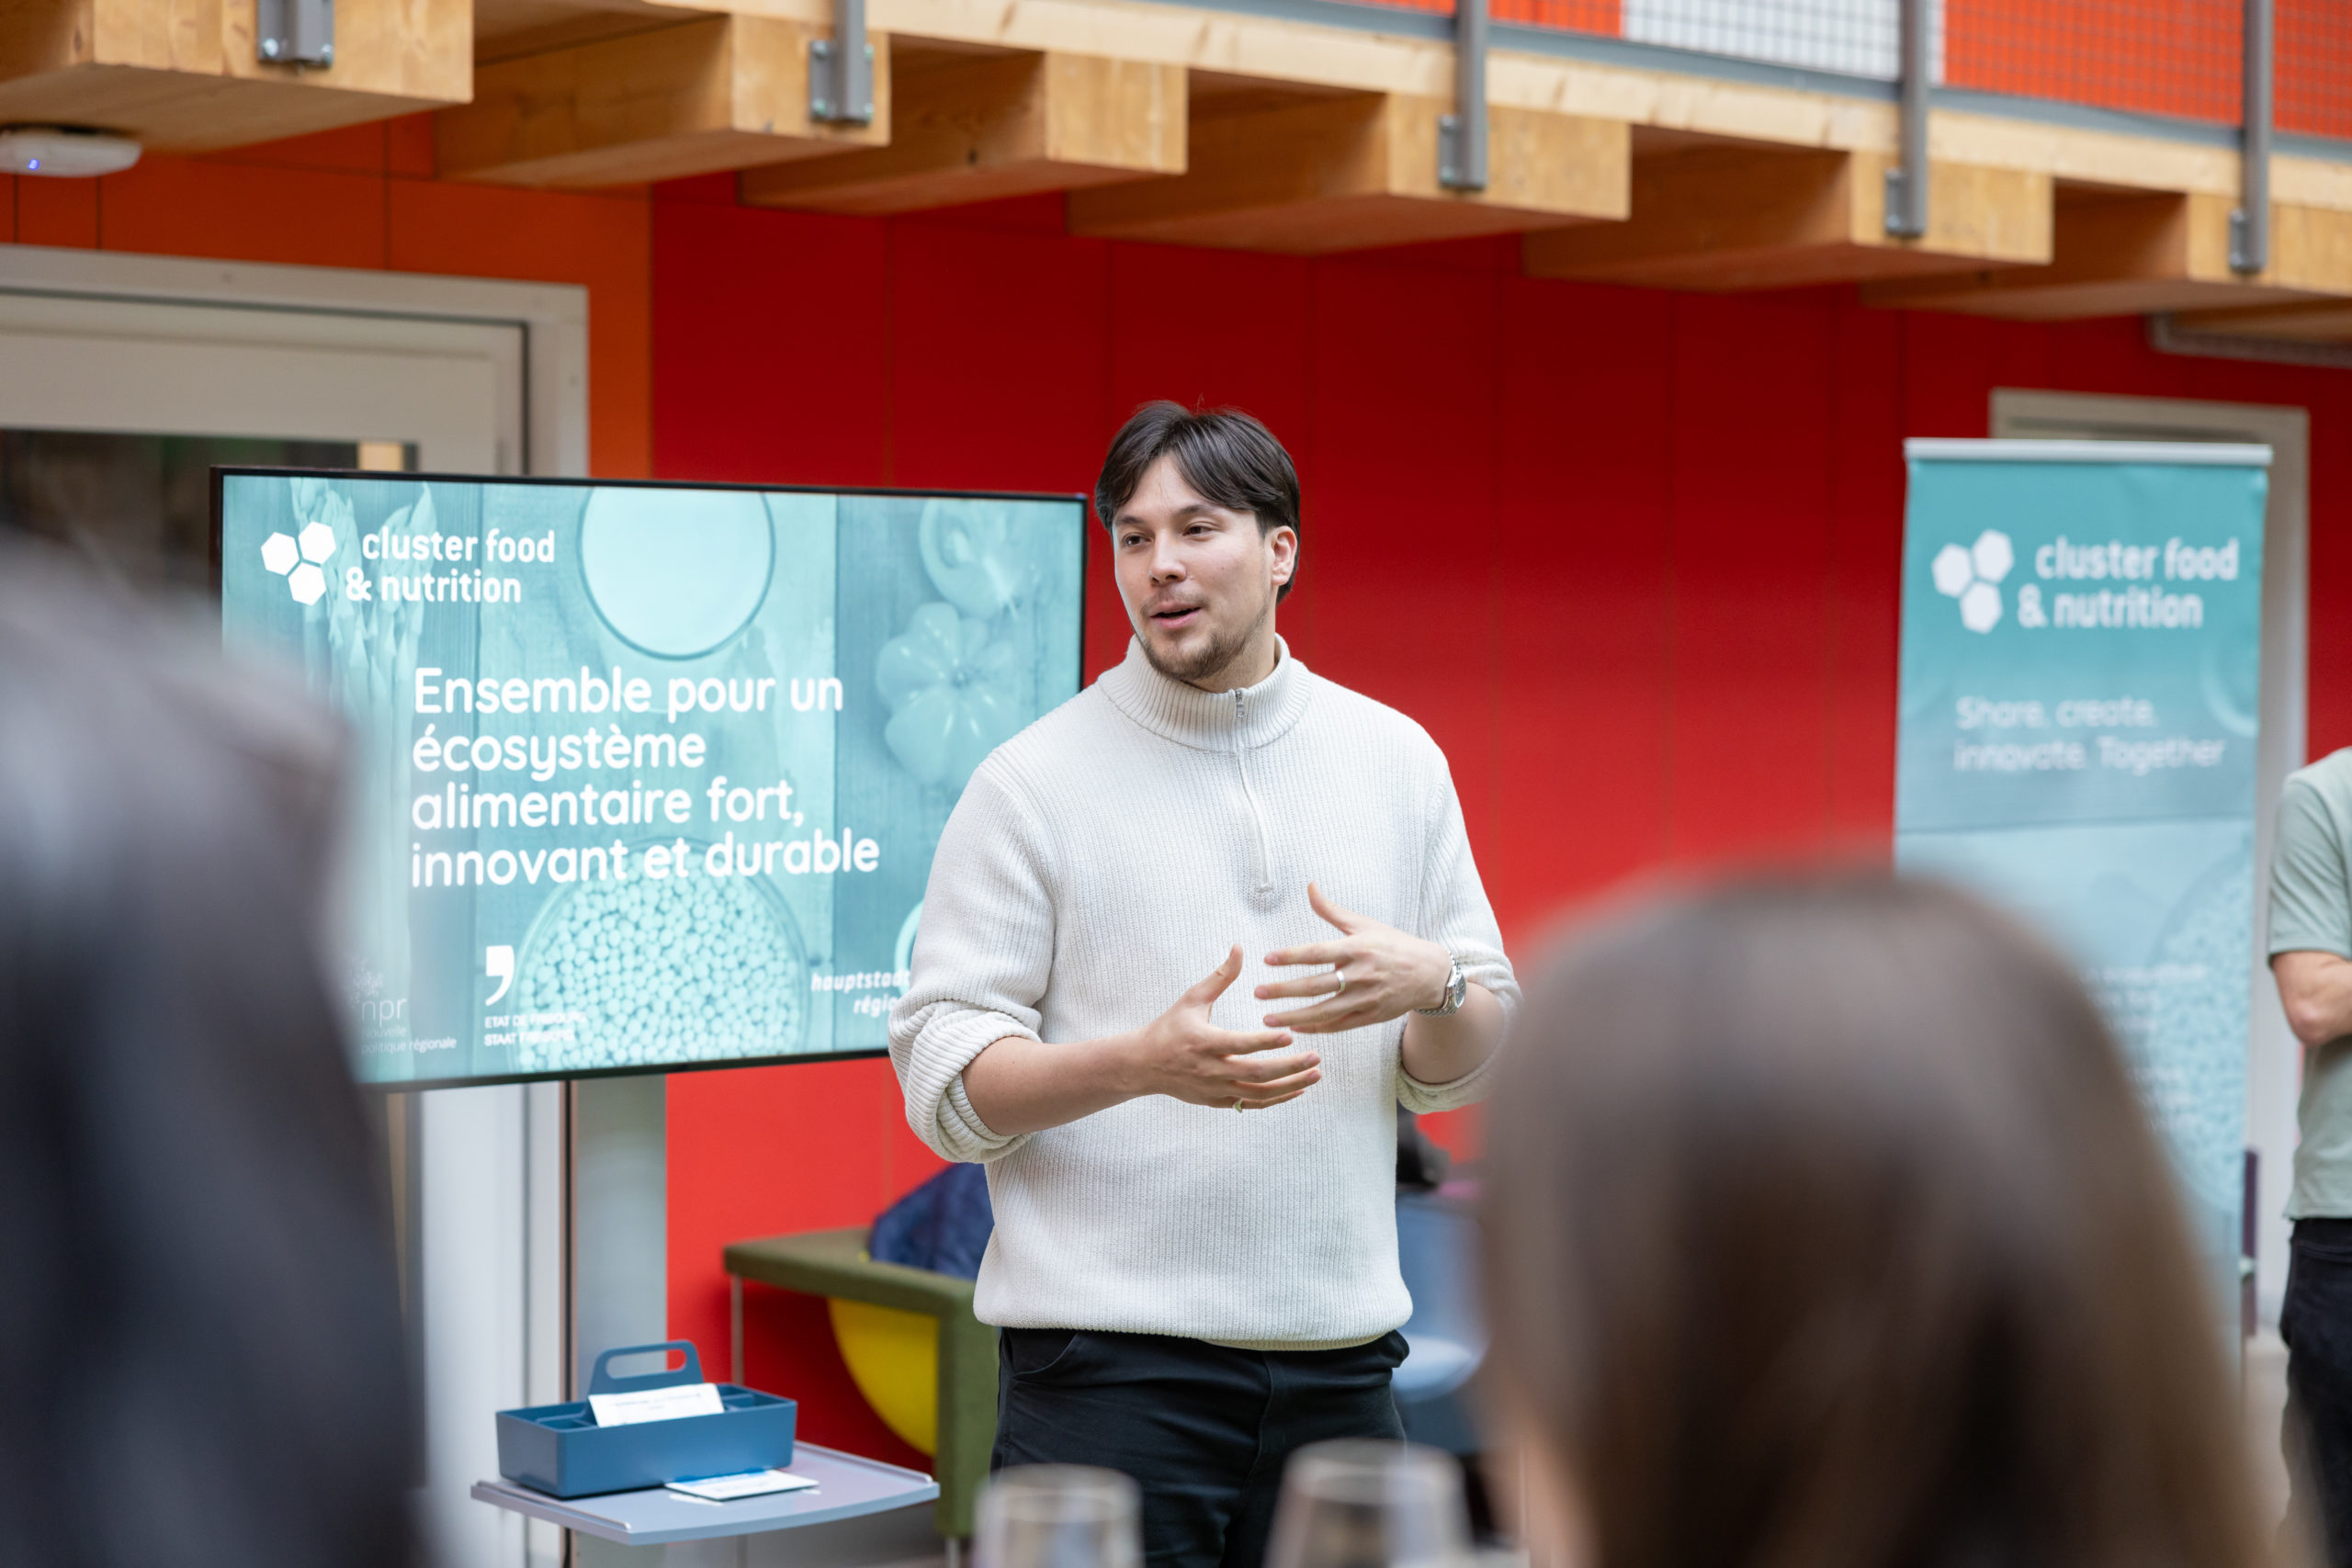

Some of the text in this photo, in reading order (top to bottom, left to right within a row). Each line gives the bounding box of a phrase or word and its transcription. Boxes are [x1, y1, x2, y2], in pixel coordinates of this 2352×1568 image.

[362, 526, 555, 563] cluster food
[2035, 535, 2239, 581] cluster food
[345, 567, 521, 603] & nutrition
[2018, 583, 2203, 628] & nutrition
[414, 665, 843, 724] Ensemble pour un
[413, 723, 707, 782] écosystème
[412, 776, 805, 829] alimentaire fort,
[413, 828, 880, 887] innovant et durable
[362, 998, 407, 1028] npr
[853, 995, 899, 1018] régio
